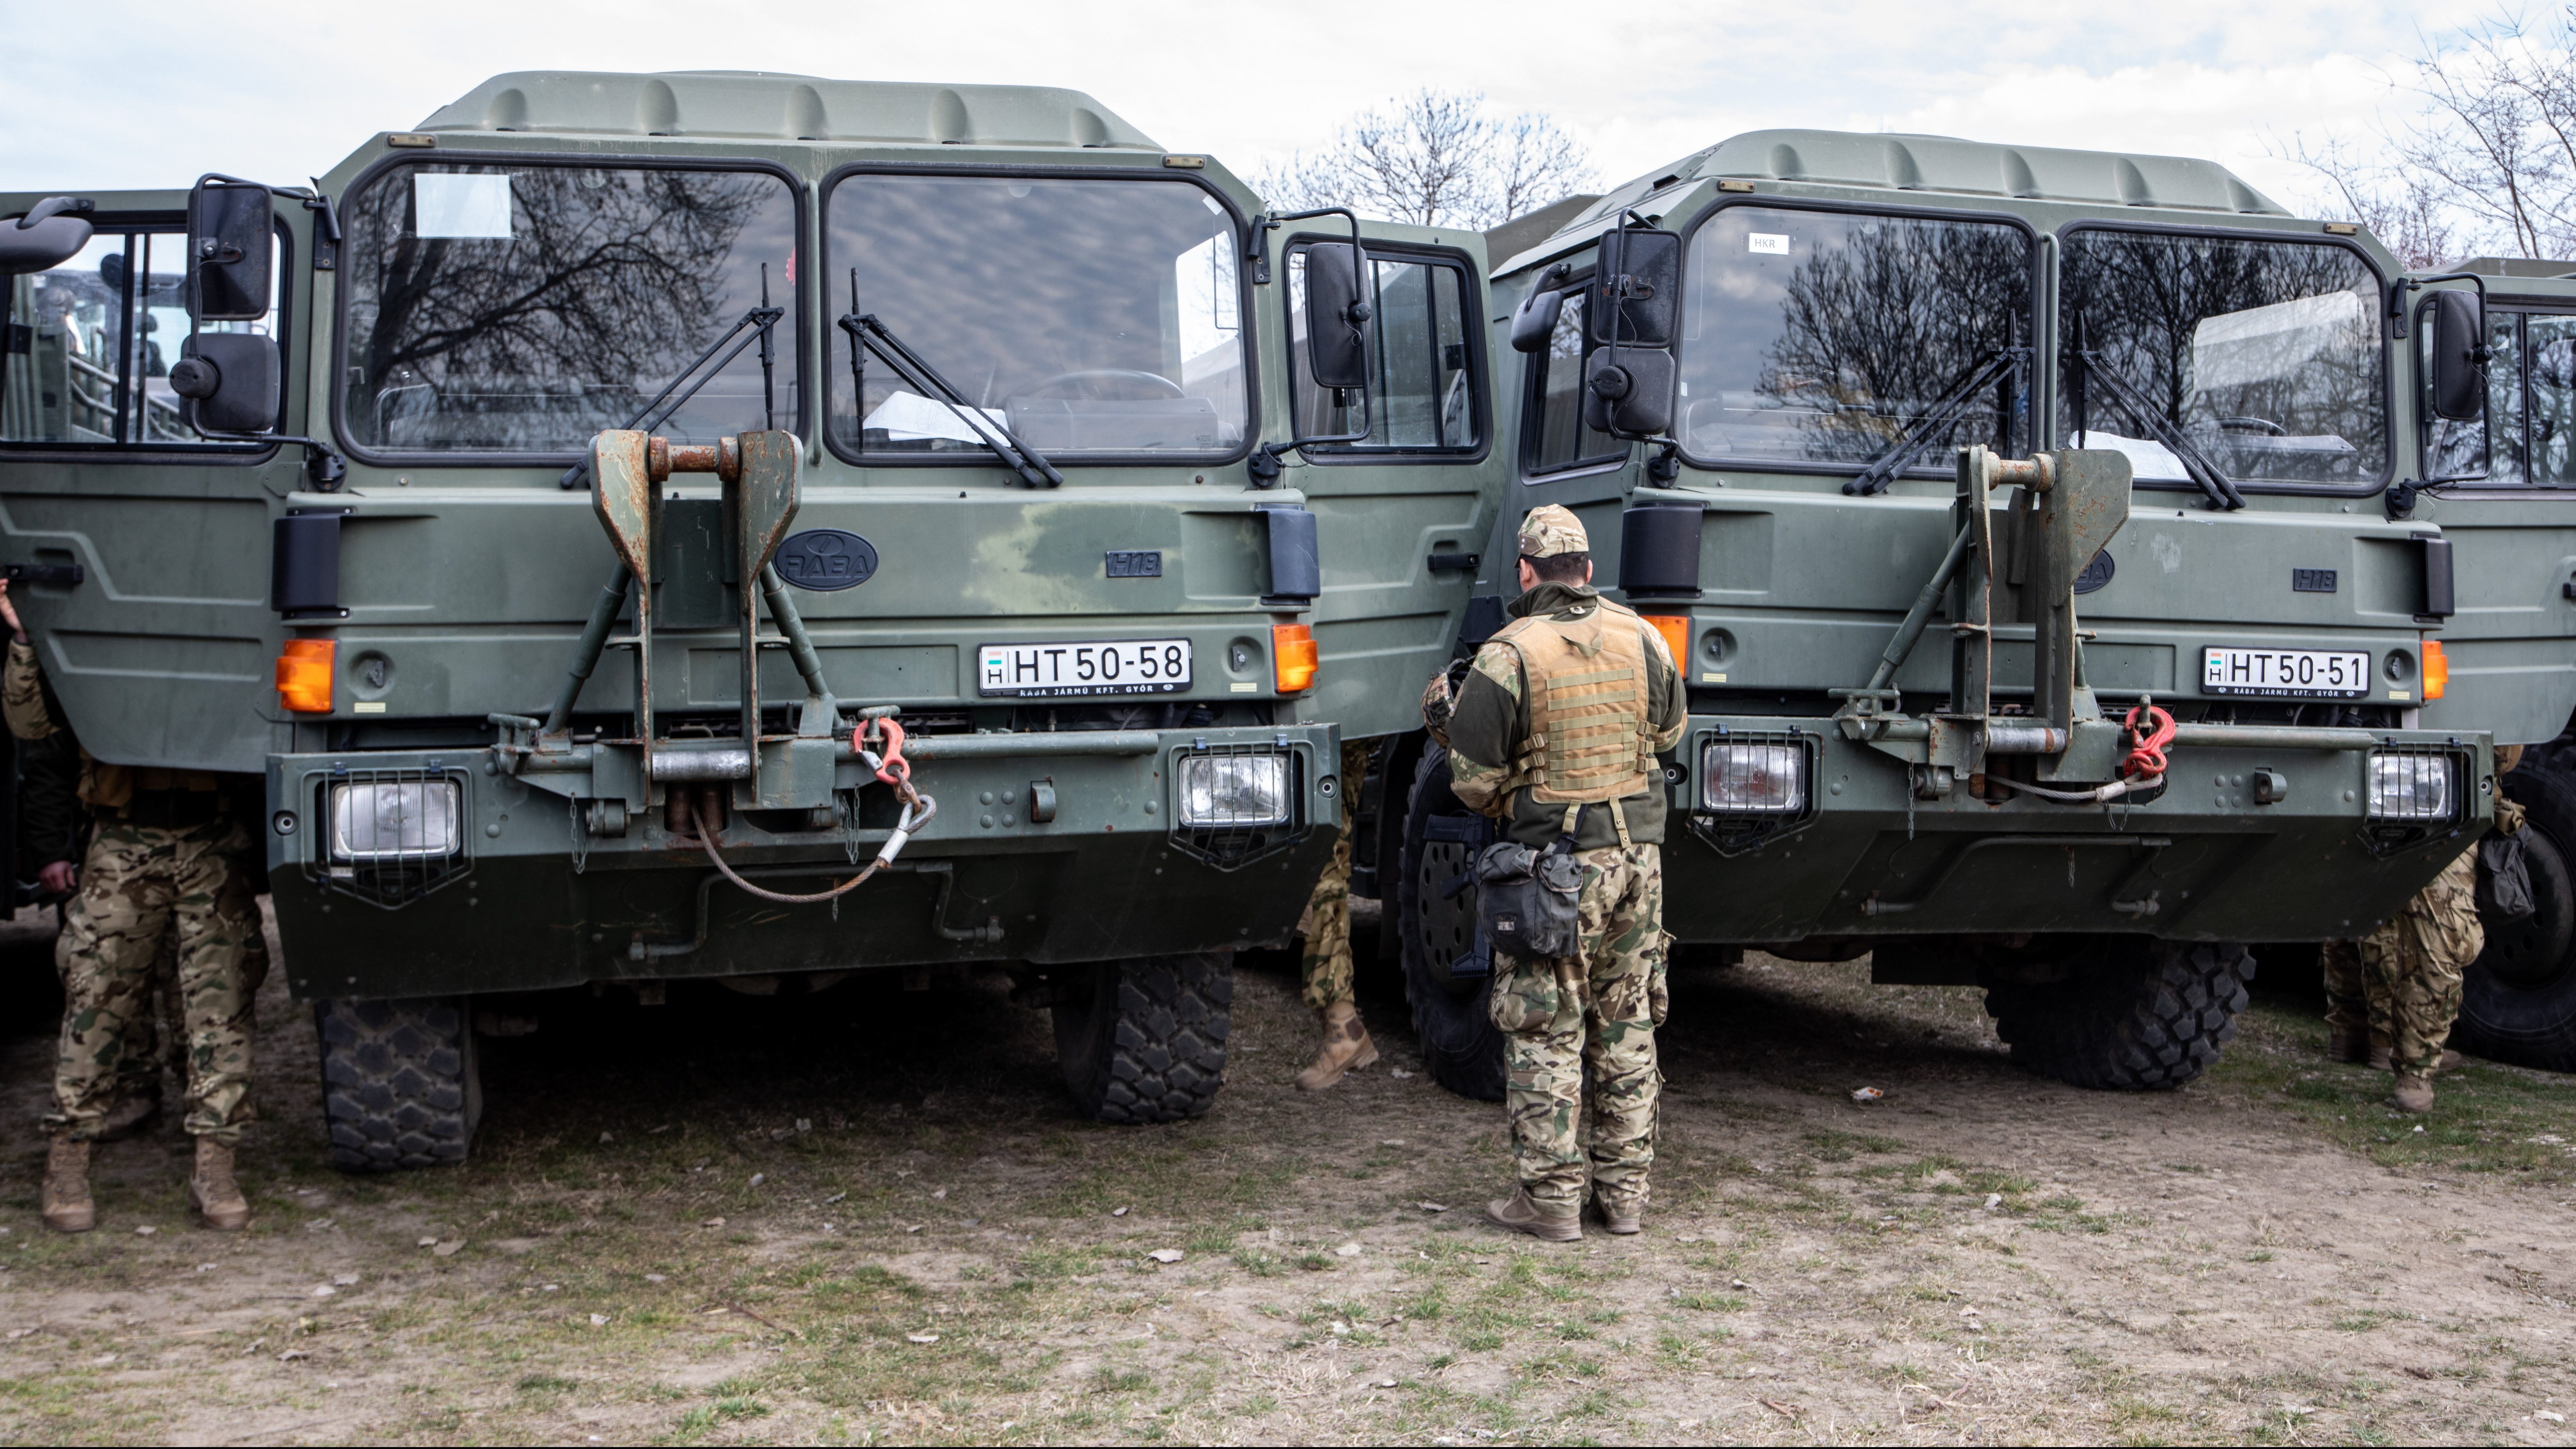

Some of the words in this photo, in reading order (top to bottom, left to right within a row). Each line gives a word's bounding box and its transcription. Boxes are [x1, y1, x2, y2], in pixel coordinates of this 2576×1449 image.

[1755, 238, 1775, 248] HKR
[1109, 553, 1160, 576] H18
[2296, 570, 2336, 591] H18
[988, 669, 1002, 683] H
[2210, 668, 2221, 682] H
